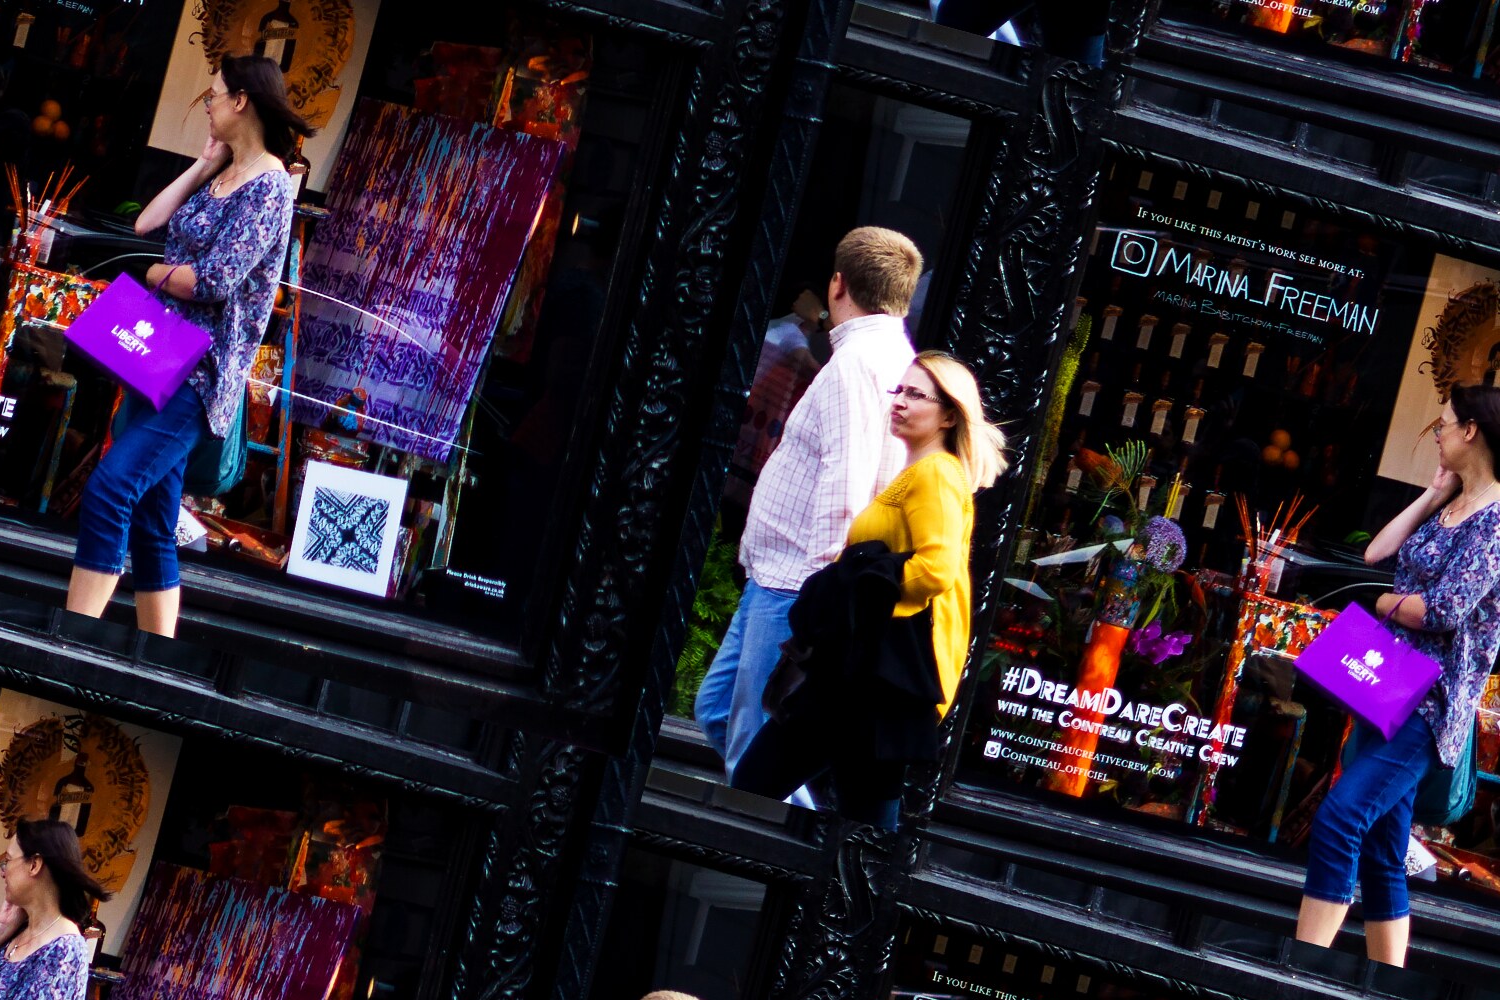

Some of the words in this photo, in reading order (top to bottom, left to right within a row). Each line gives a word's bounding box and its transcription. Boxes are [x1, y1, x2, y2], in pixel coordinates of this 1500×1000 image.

[111, 324, 151, 355] LIBERTY
[447, 569, 462, 577] Please
[478, 576, 506, 588] Responsibly
[1341, 653, 1381, 684] LIBERTY
